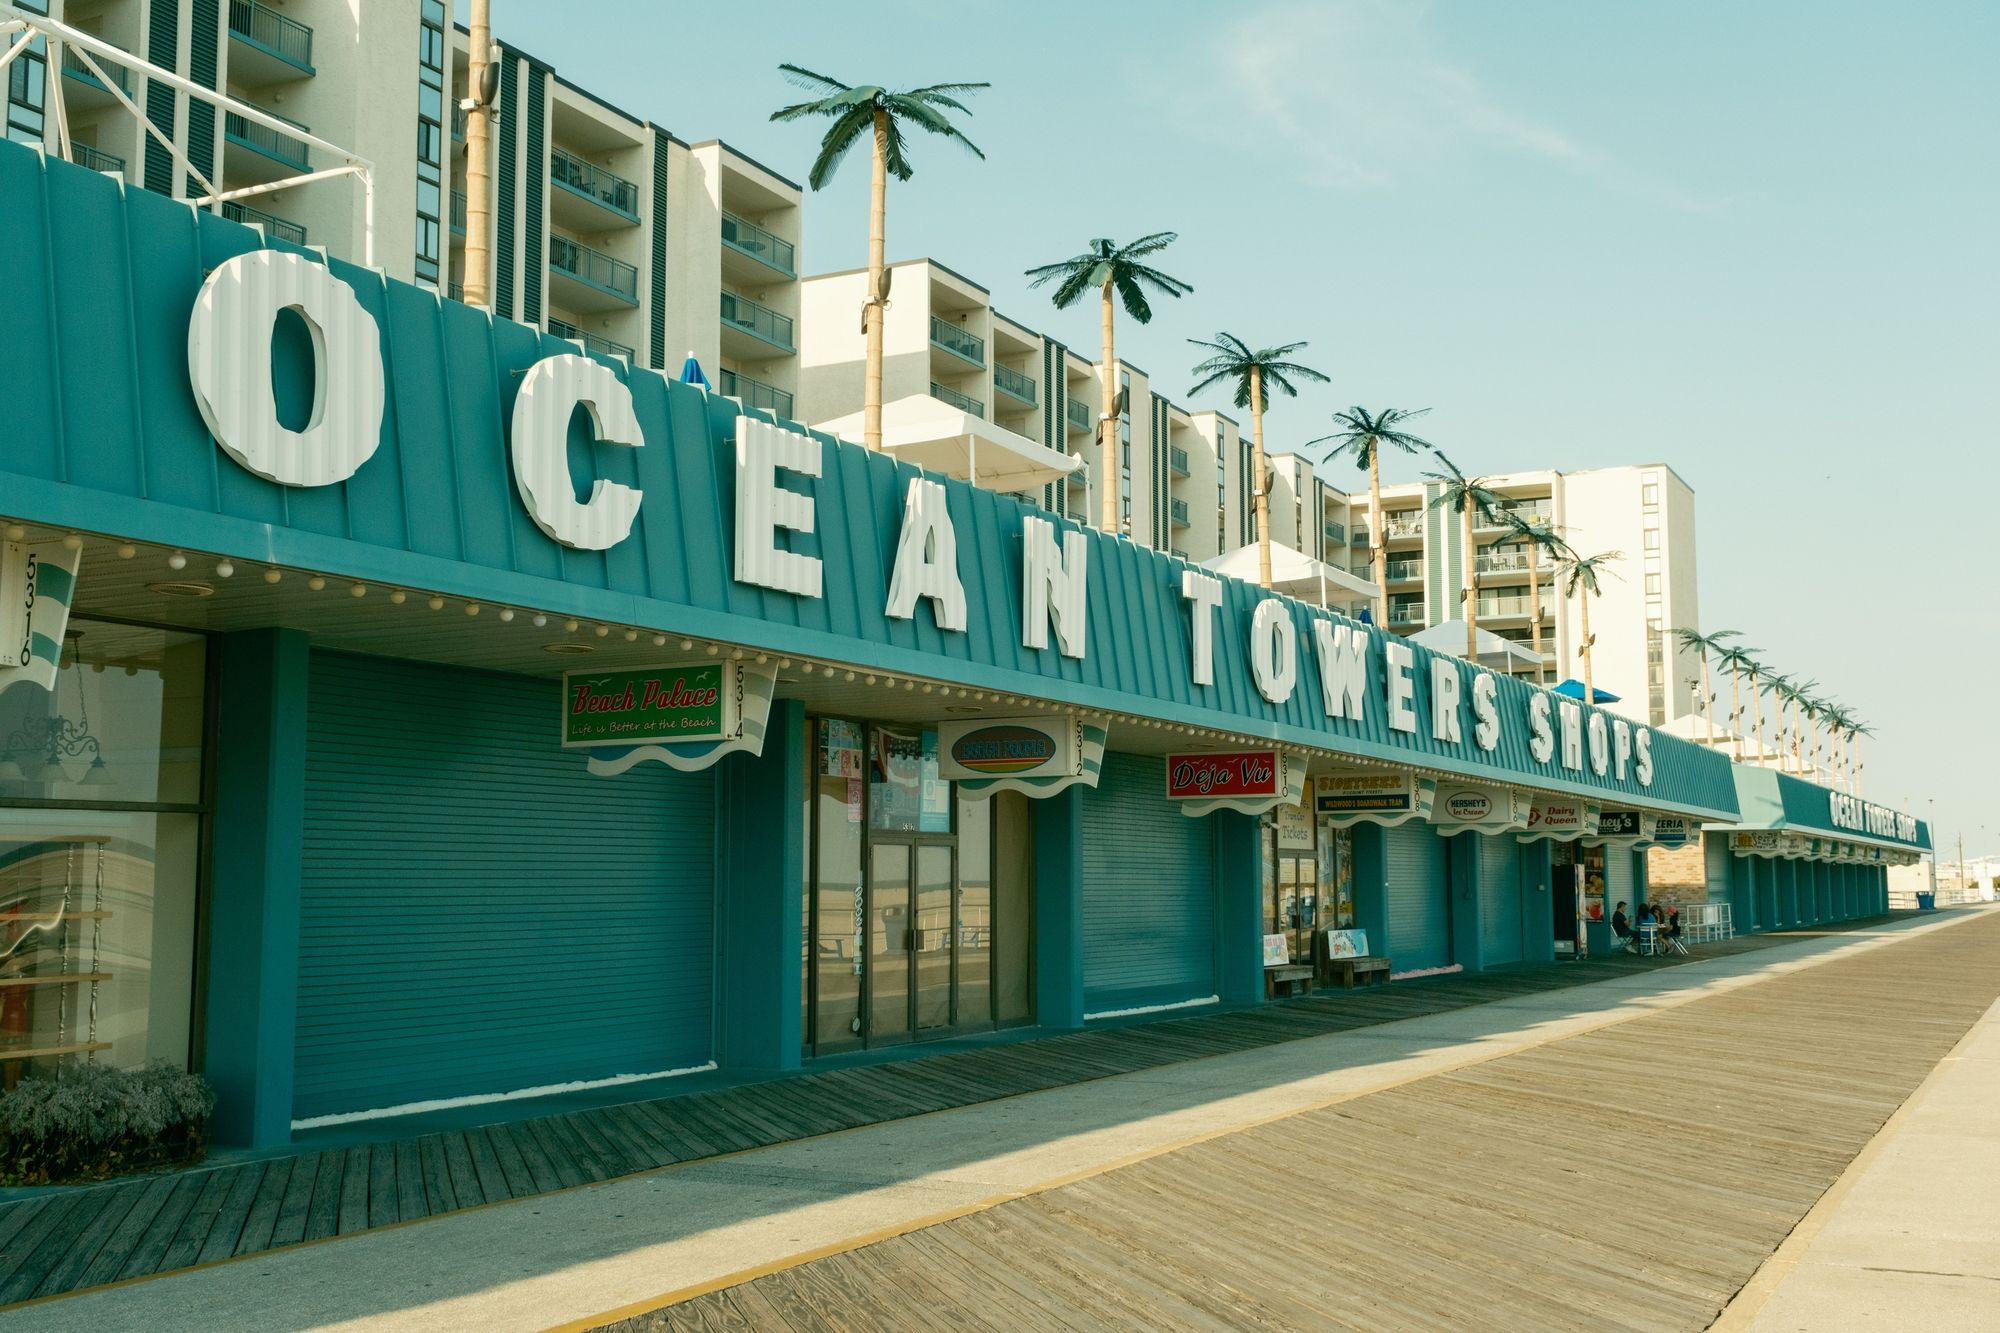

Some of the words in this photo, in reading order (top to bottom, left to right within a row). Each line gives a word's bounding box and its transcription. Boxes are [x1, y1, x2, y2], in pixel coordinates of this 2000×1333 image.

[188, 249, 1087, 658] OCEAN
[1182, 570, 1499, 751] TOWERS
[1530, 692, 1653, 787] SHOPS
[20, 553, 37, 667] 5316
[572, 681, 637, 715] Beach
[641, 677, 718, 711] Palace
[735, 665, 744, 739] 5314
[572, 722, 592, 735] Life
[597, 723, 606, 733] is
[609, 721, 640, 733] Better
[643, 720, 657, 730] at
[658, 719, 676, 729] the
[681, 716, 716, 728] Beach
[1173, 760, 1234, 794] Deja
[1240, 758, 1273, 787] Vu
[1450, 799, 1487, 807] HERSHEY'S
[1544, 816, 1577, 825] Queen
[1547, 806, 1575, 816] Dairy
